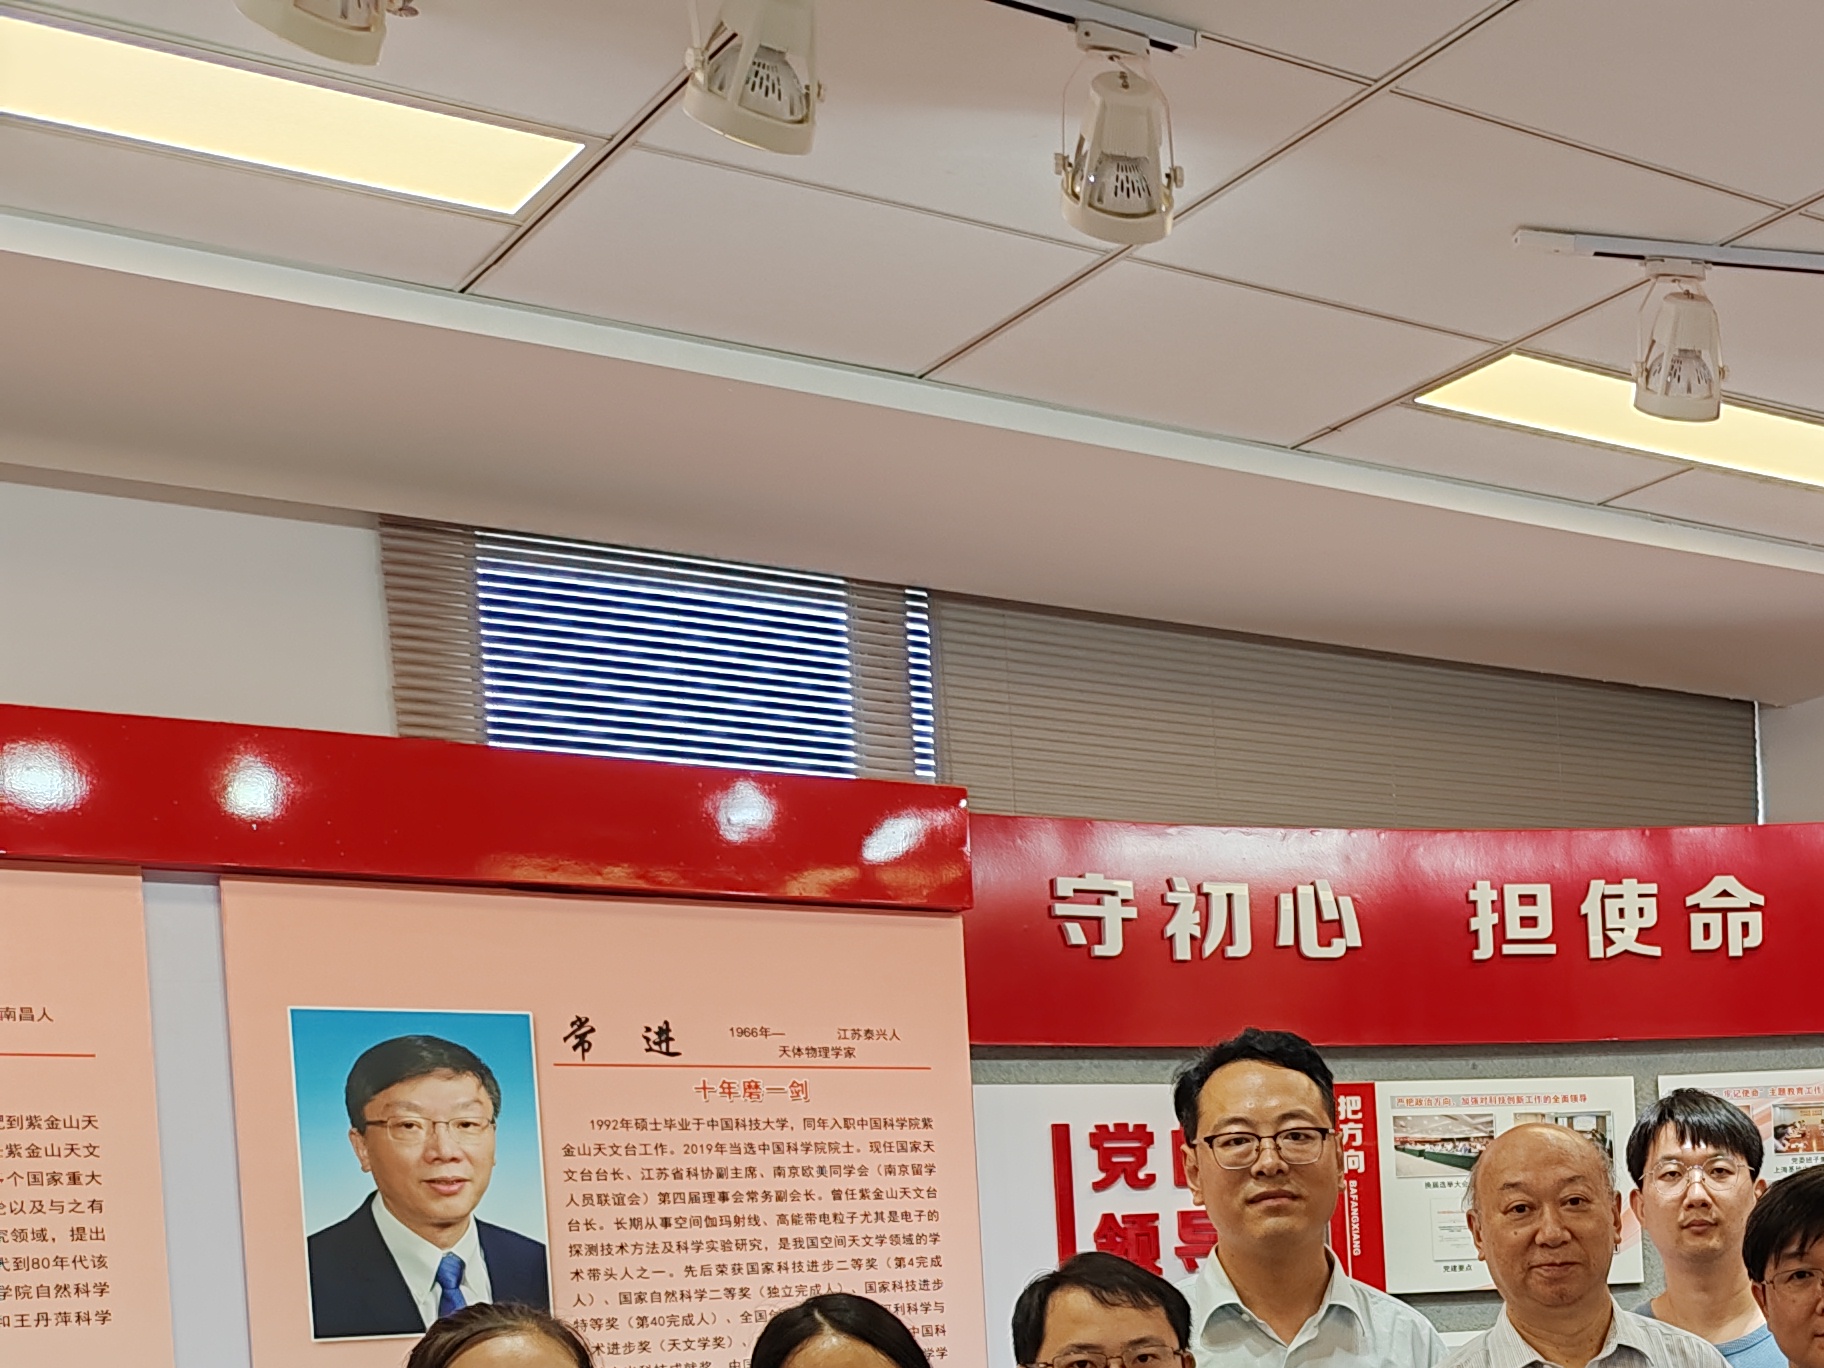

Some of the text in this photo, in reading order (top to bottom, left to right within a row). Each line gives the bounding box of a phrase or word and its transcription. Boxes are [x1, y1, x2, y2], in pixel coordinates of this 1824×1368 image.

[1048, 872, 1766, 962] 守初心 担使命
[837, 1028, 902, 1042] 江苏泰兴人
[778, 1045, 857, 1059] 天体物理学家
[694, 1079, 810, 1102] 十年磨一剑
[0, 1114, 99, 1131] 到紫金山天
[0, 1142, 101, 1159] 紫金山天文
[0, 1171, 103, 1187] 个国家重大
